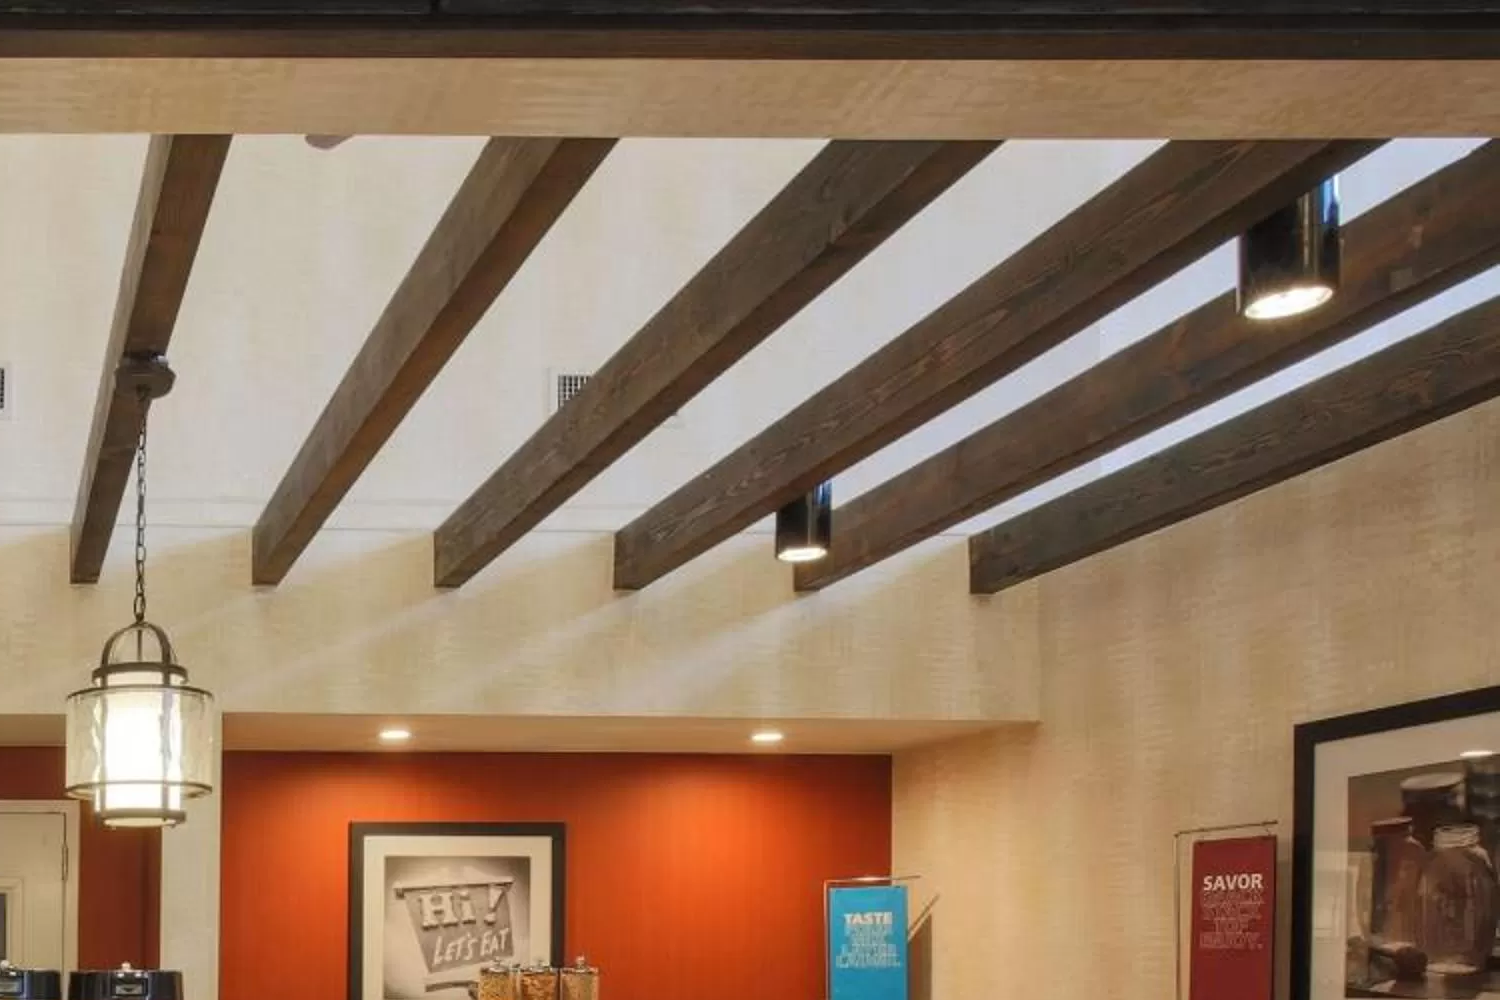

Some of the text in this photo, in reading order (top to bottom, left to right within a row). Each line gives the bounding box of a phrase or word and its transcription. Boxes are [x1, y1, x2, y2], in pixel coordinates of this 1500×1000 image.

[1203, 873, 1264, 891] SAVOR
[843, 911, 893, 926] TASTE
[432, 928, 509, 966] LET'S EAT
